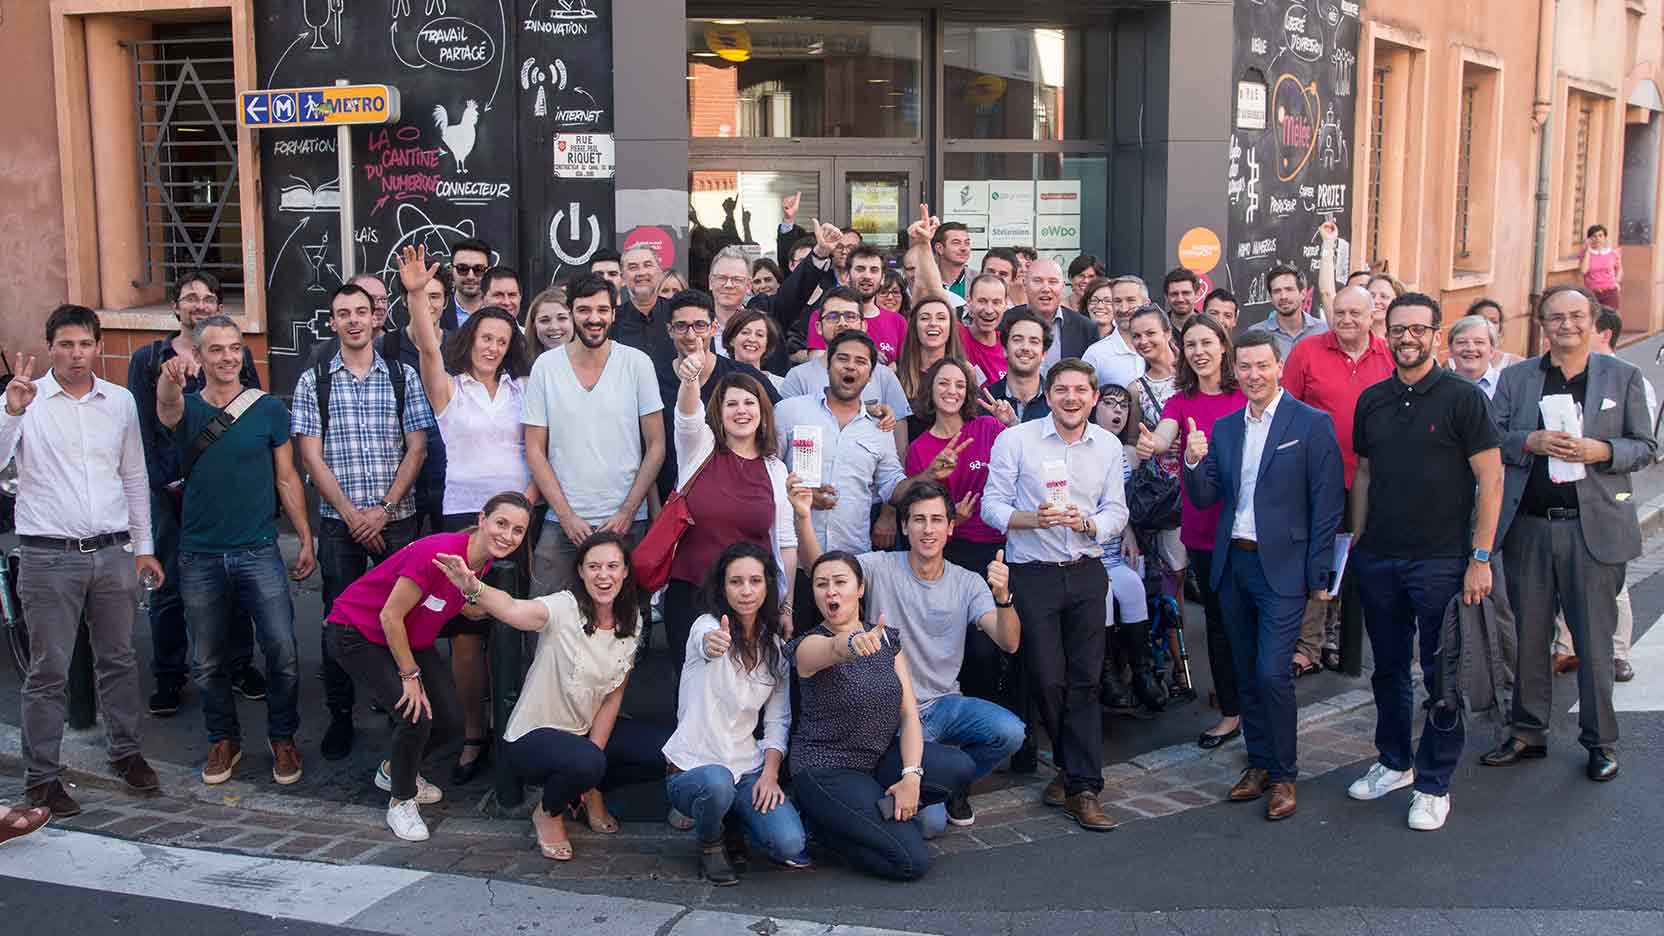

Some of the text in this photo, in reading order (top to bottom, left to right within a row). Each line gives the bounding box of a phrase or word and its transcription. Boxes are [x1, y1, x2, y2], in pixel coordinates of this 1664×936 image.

[439, 41, 486, 63] PARTAGÉ
[368, 128, 391, 151] LA
[575, 135, 593, 145] RUE
[382, 146, 440, 168] CANTINE
[567, 152, 603, 164] RIQUET
[365, 163, 384, 180] DU
[435, 180, 511, 198] CONNECTEUR
[1317, 184, 1347, 208] PROJET
